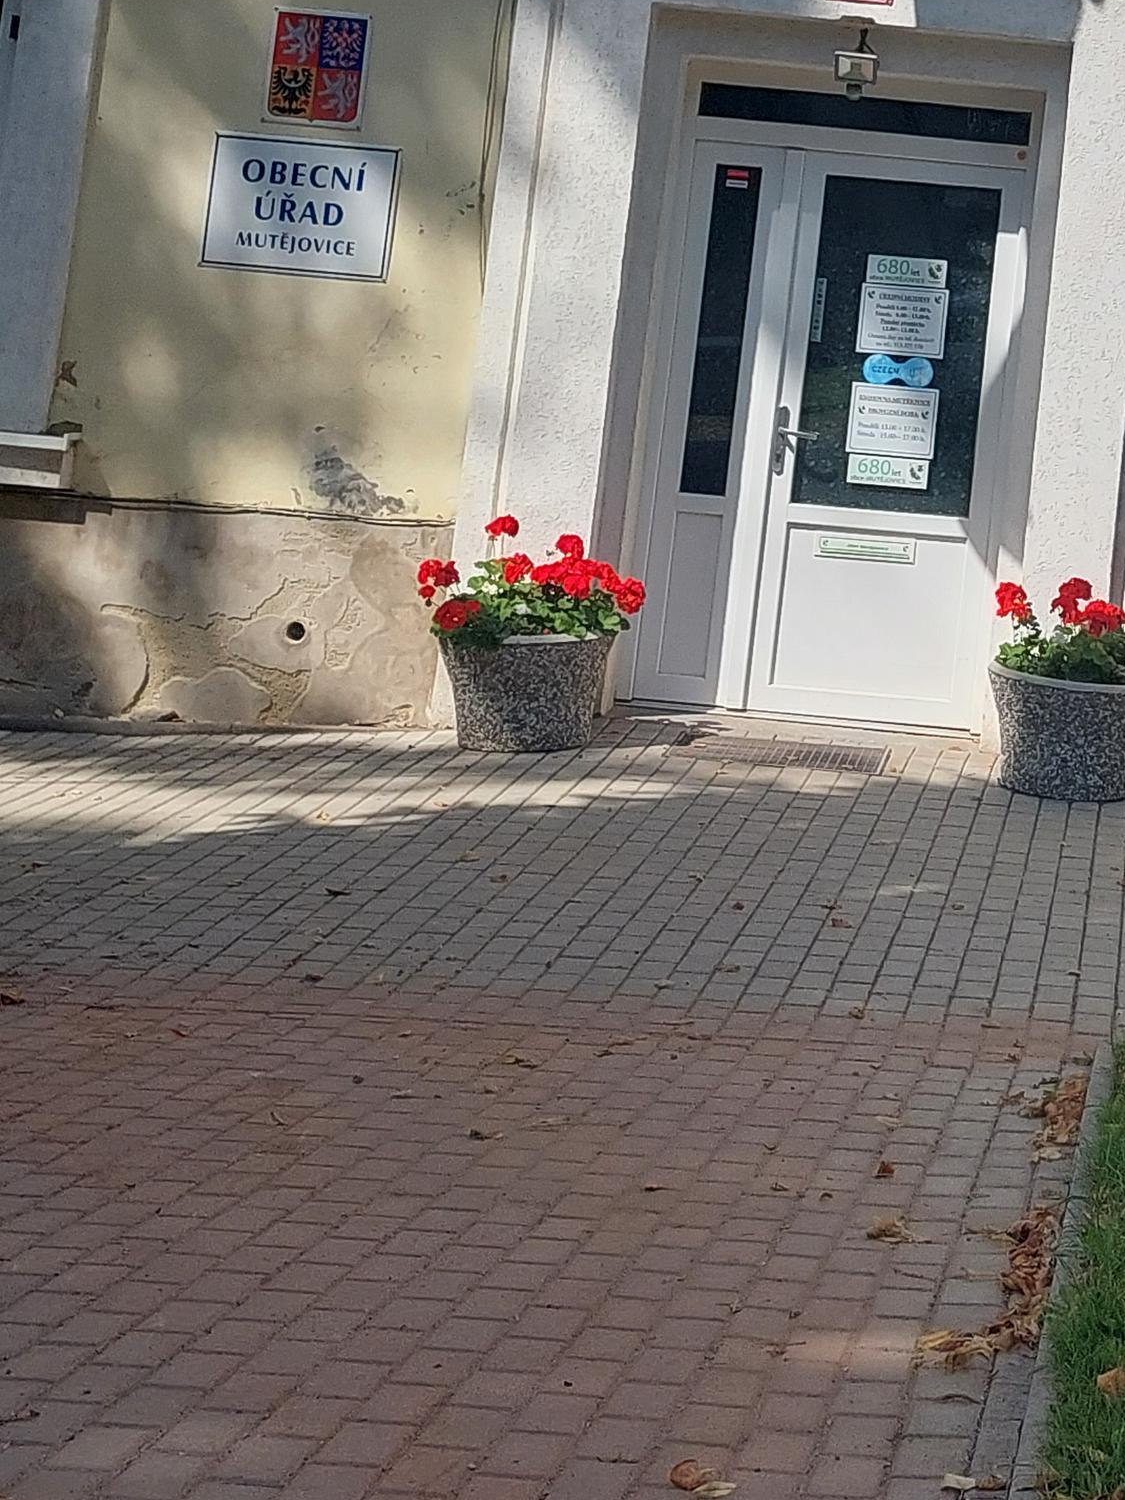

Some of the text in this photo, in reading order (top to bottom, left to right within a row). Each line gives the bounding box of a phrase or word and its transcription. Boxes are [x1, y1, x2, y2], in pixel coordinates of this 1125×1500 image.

[241, 158, 368, 192] OBECNÍ
[254, 190, 345, 227] ÚŘAD
[235, 231, 356, 257] MUTĚJOVICE
[877, 258, 910, 276] 680
[857, 458, 891, 476] 680
